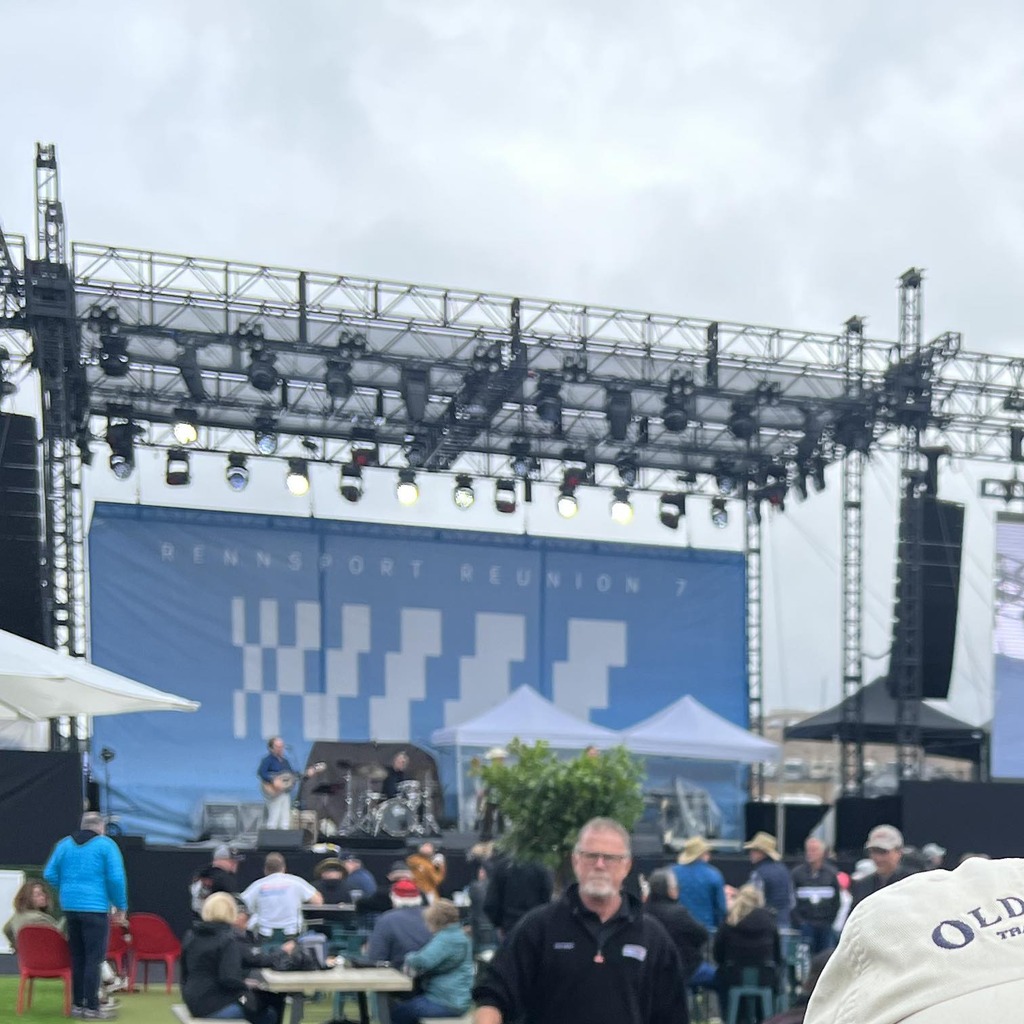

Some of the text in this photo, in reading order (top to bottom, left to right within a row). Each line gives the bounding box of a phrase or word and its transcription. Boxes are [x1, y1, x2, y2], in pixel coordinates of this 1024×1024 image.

[161, 541, 688, 598] RENNSPORT REUNION 7
